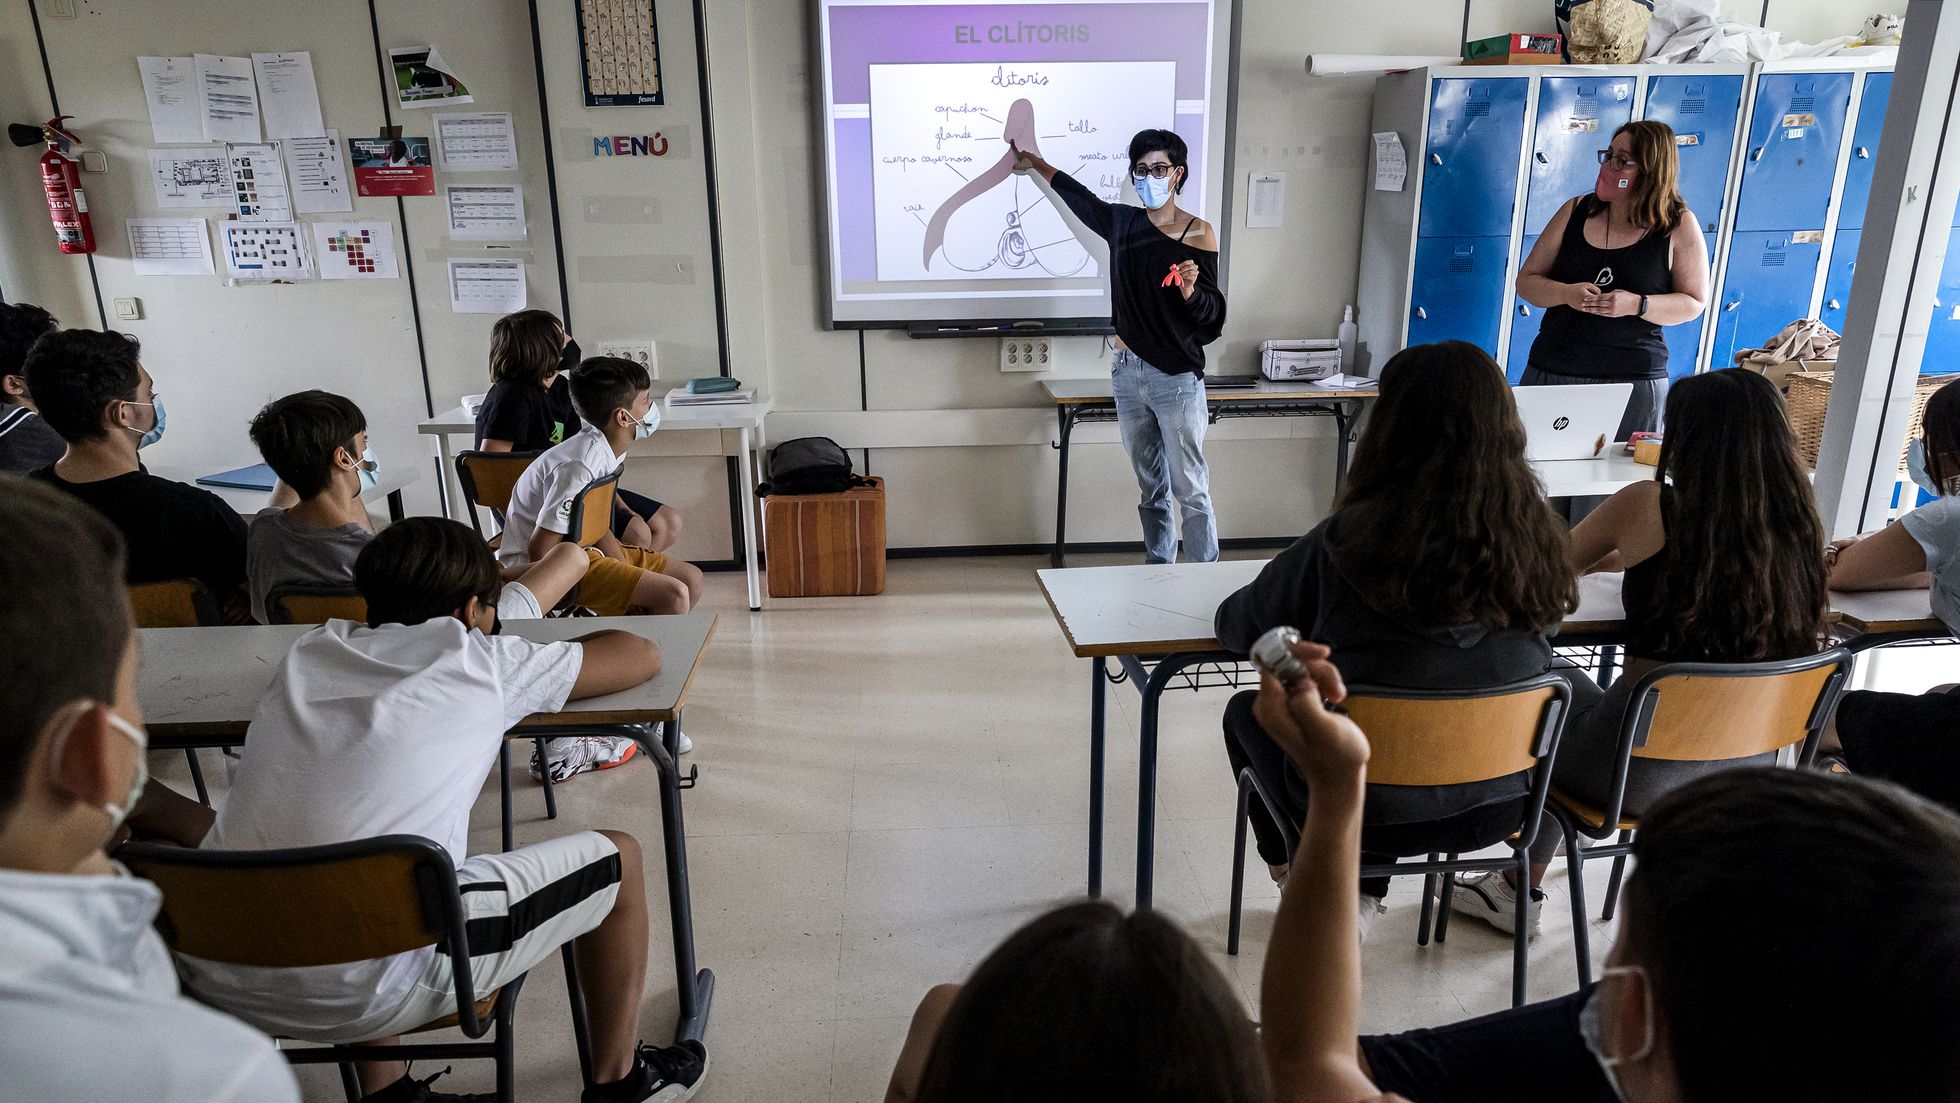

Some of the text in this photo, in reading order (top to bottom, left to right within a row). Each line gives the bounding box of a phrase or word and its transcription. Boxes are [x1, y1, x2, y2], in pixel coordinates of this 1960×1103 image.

[955, 20, 1090, 44] EL CLÍTORIS
[1068, 119, 1098, 134] tallo
[593, 132, 669, 157] MENÚ
[935, 126, 973, 150] glande
[882, 155, 973, 173] cuerpo cavernoso
[1079, 151, 1108, 161] meato
[1553, 416, 1570, 432] hp
